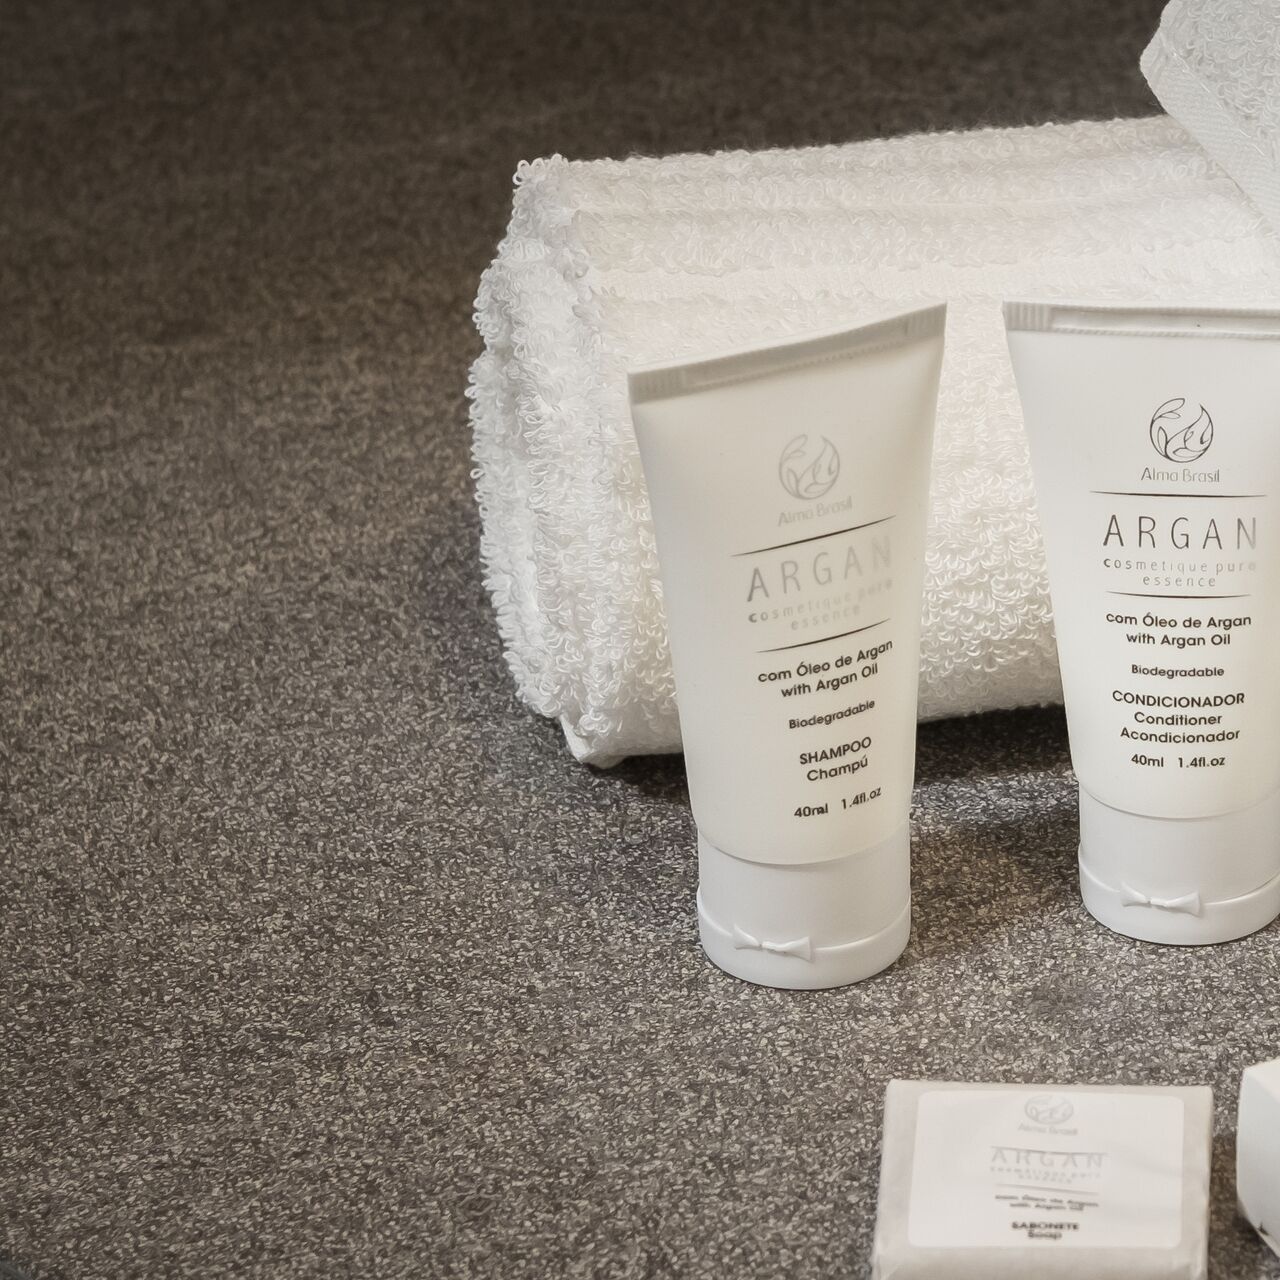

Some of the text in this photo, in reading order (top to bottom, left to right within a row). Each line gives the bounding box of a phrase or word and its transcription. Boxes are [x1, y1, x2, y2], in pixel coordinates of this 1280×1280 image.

[1141, 467, 1219, 482] Alma Brasil
[1103, 515, 1256, 550] ARGAN
[747, 536, 891, 602] ARGAN
[1103, 558, 1207, 574] cosmetique
[1143, 576, 1215, 587] essence
[791, 605, 861, 630] essence
[1106, 612, 1251, 630] com Óleo de Argan
[1126, 633, 1230, 649] with Argan Oil
[758, 641, 893, 682] com Óleo de Argan
[781, 663, 878, 697] with Argan Oil
[1132, 664, 1224, 679] Biodegradable
[1112, 690, 1245, 708] CONDICIONADOR
[789, 700, 875, 729] Biodegradable
[1134, 711, 1222, 726] Conditioner
[1120, 727, 1240, 743] Acondicionador
[800, 736, 871, 764] SHAMPOO
[807, 754, 868, 781] Champú
[1131, 754, 1164, 767] 40ml
[794, 803, 828, 817] 40ml
[991, 1148, 1102, 1168] ARGAN
[1012, 1222, 1079, 1230] SABONETE
